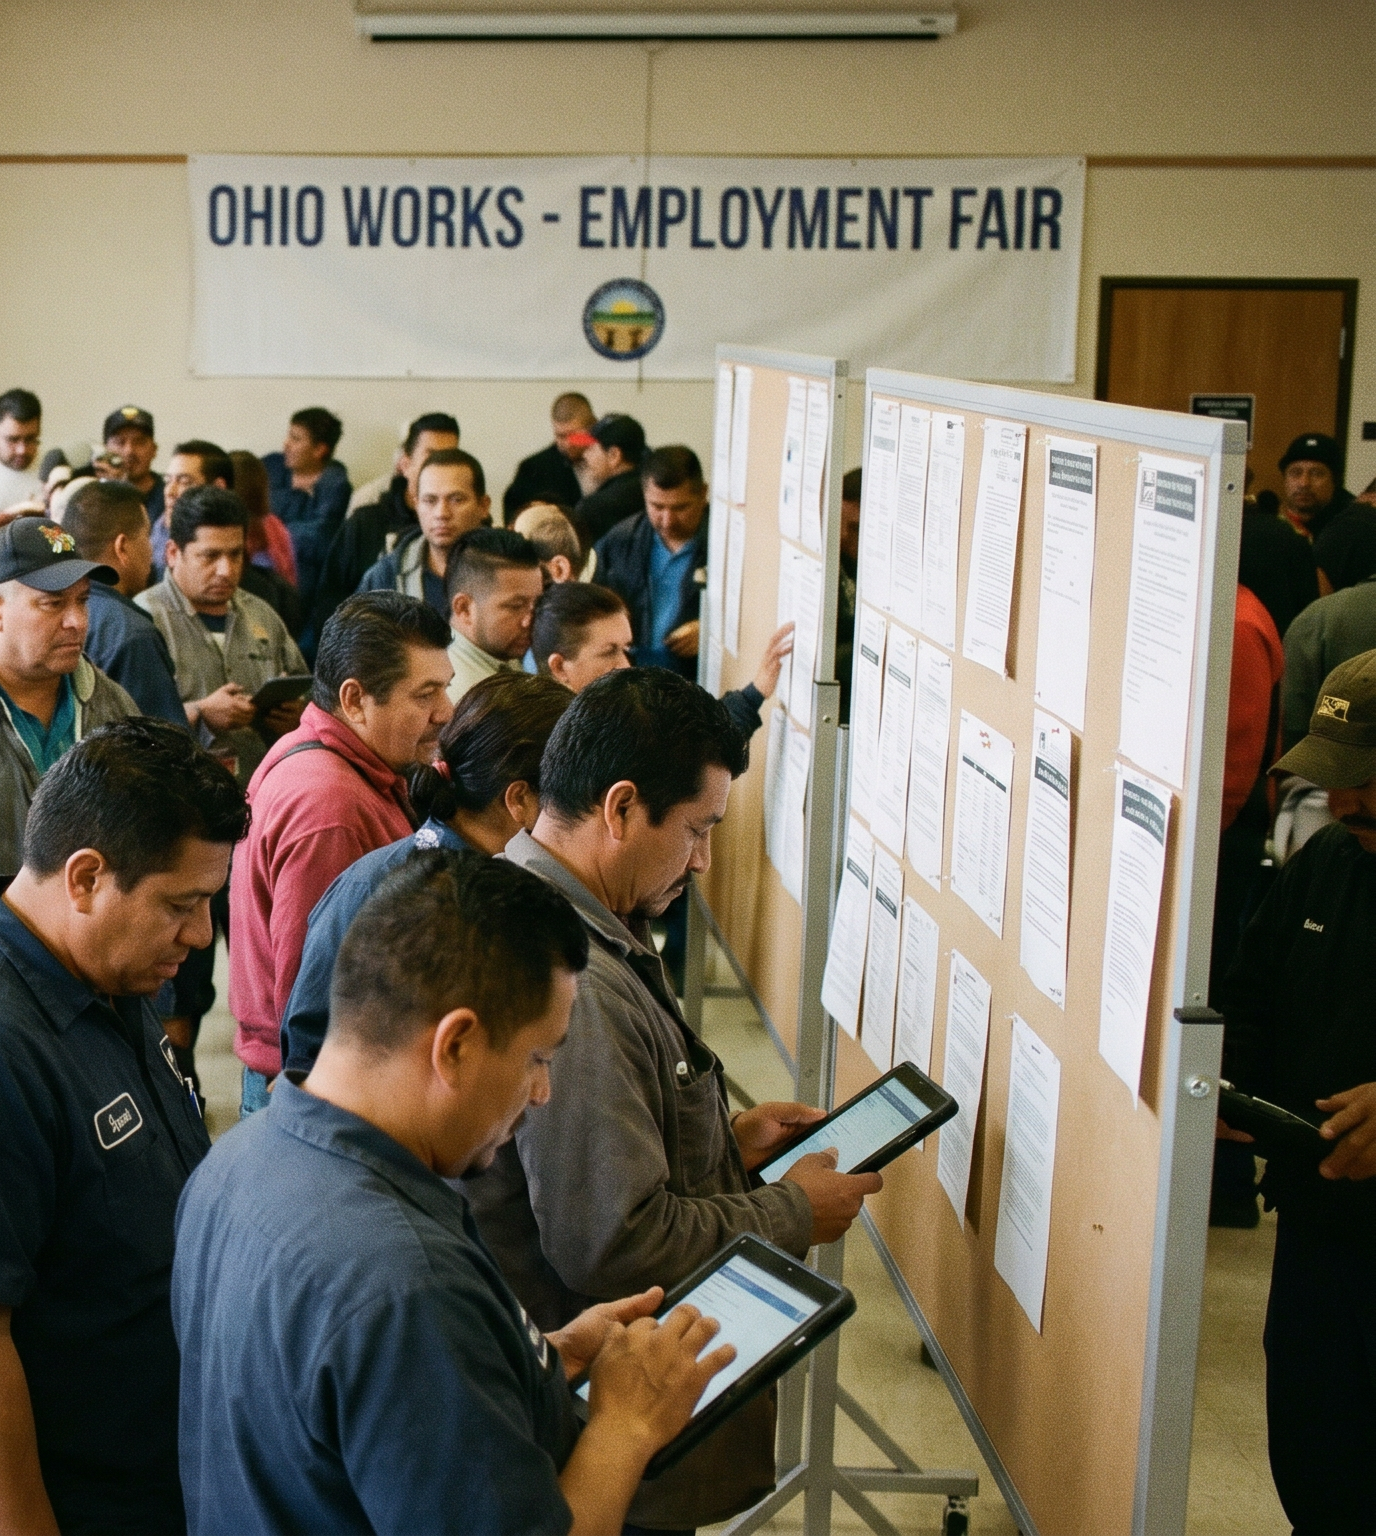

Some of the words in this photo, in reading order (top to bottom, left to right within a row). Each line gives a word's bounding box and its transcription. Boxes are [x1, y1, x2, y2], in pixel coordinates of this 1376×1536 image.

[208, 184, 324, 247] OHIO
[341, 185, 524, 249] WORKS
[577, 185, 934, 252] EMPLOYMENT
[947, 185, 1064, 252] FAIR
